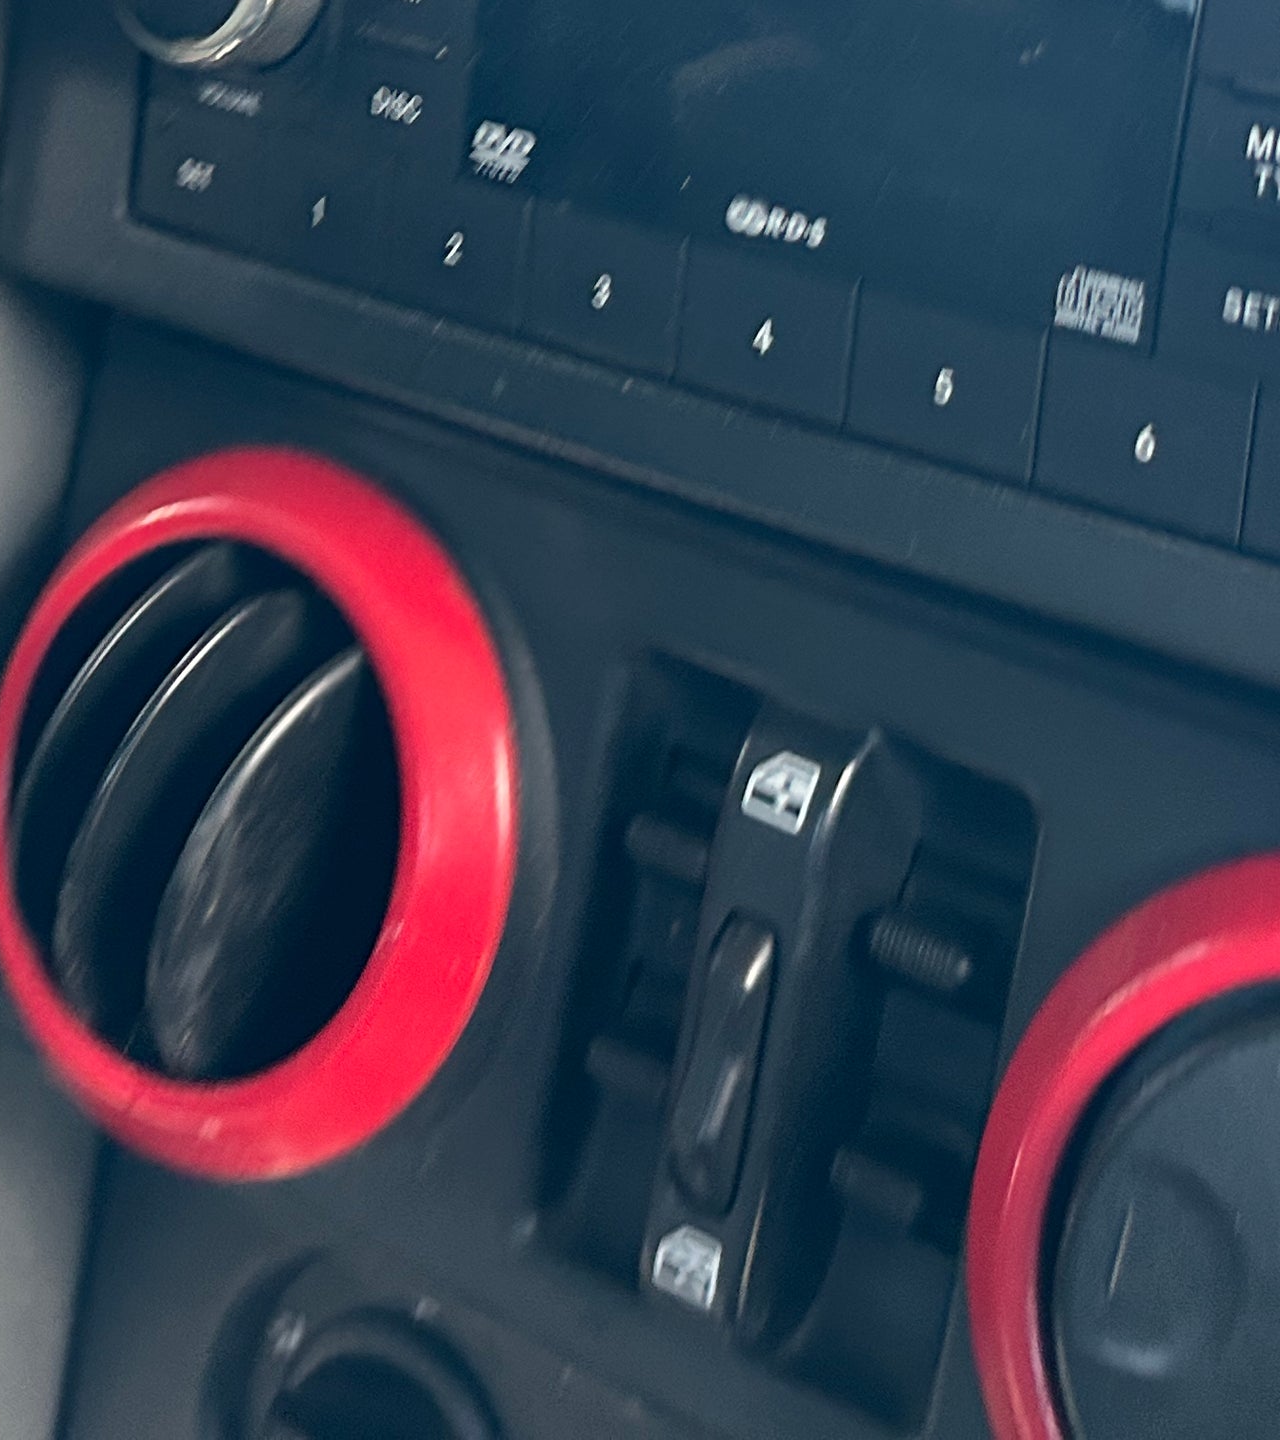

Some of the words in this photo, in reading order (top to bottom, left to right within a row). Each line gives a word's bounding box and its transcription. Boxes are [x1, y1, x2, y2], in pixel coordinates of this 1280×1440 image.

[310, 197, 326, 227] 1
[444, 232, 464, 266] 2
[591, 274, 612, 309] 3
[752, 317, 774, 356] 4
[1135, 423, 1156, 462] 6
